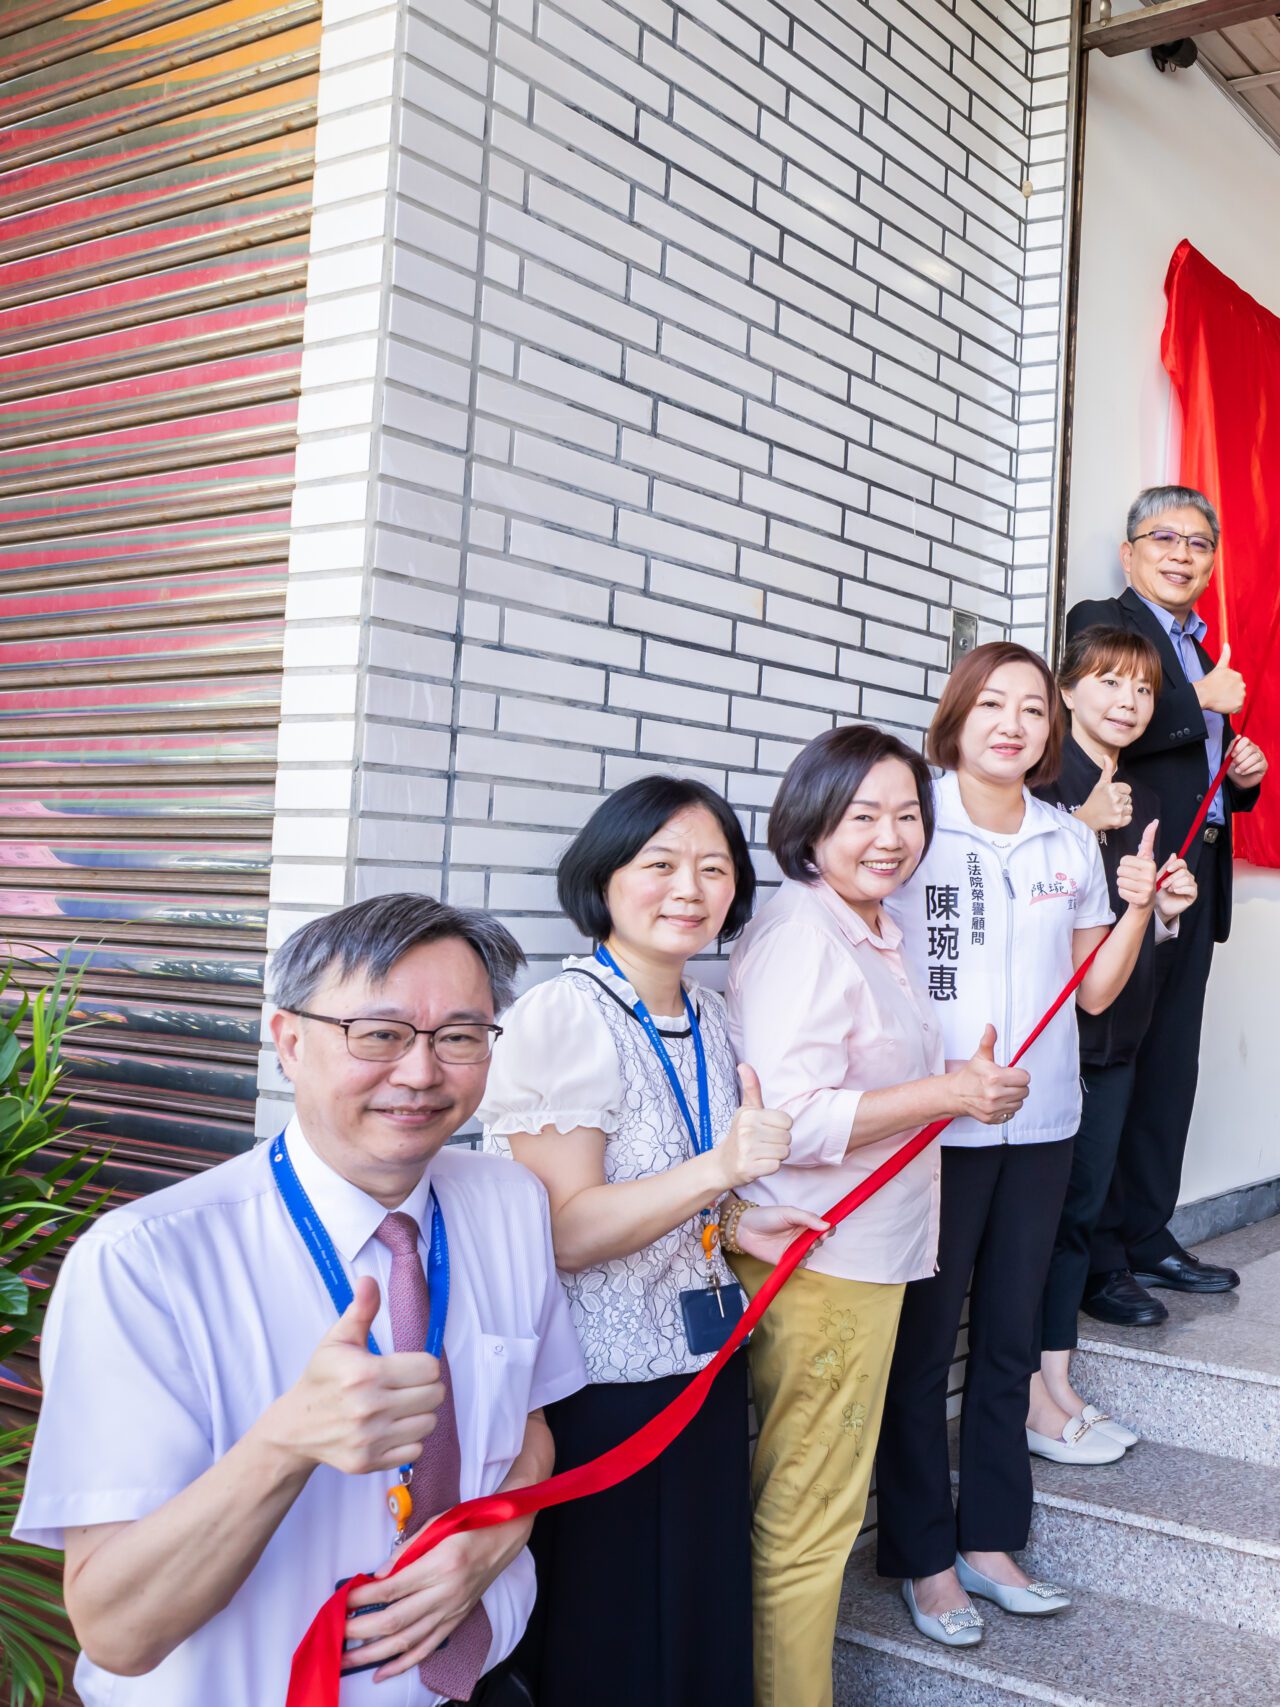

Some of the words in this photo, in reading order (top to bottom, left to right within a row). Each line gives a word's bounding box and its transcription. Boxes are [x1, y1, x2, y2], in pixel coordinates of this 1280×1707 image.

[924, 884, 961, 1001] 陳琬惠
[966, 851, 986, 946] 立法院榮譽顧問
